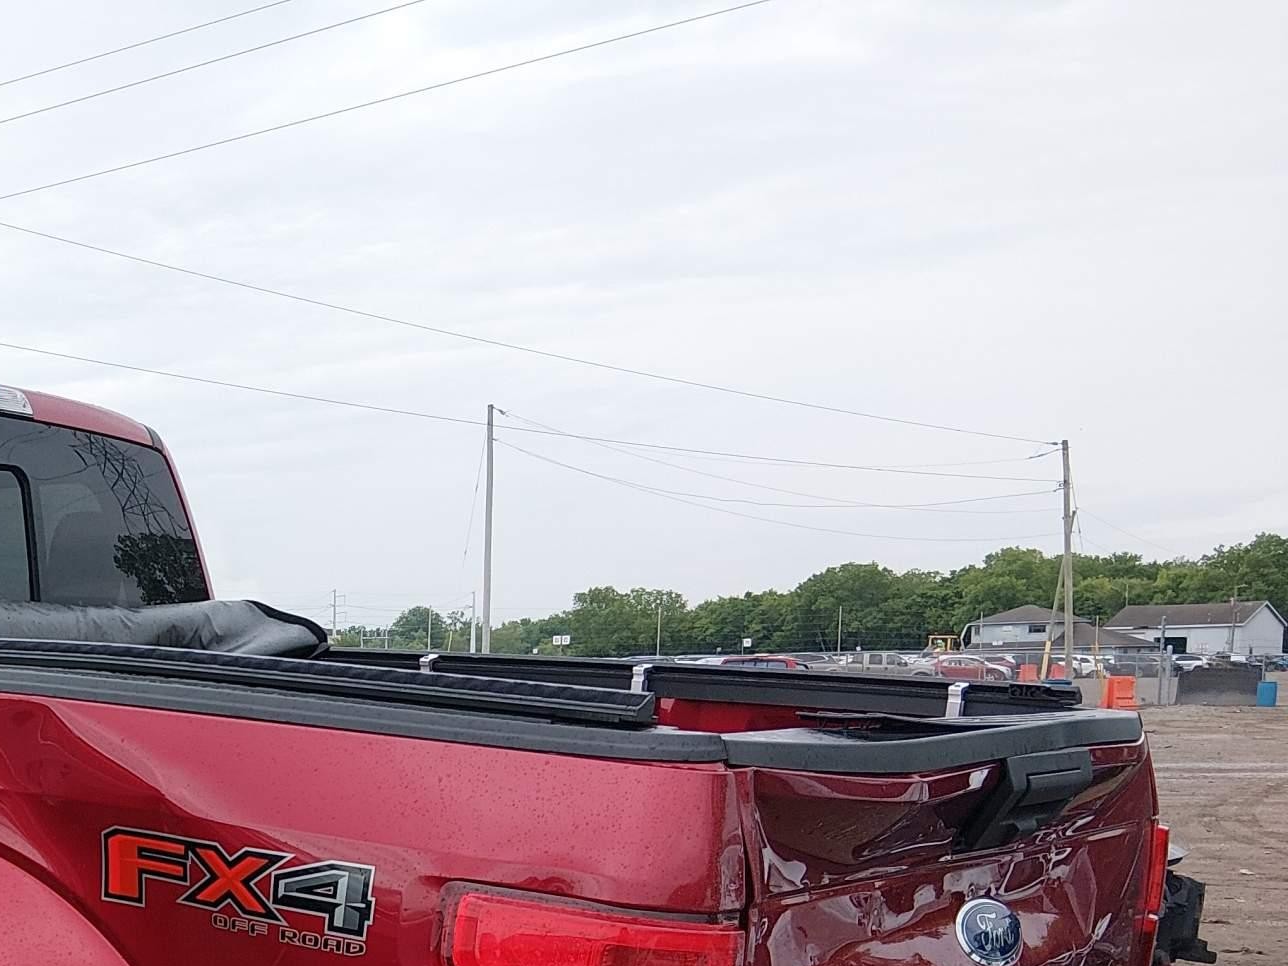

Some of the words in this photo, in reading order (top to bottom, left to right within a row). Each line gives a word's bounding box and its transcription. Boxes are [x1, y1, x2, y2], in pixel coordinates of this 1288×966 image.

[101, 825, 376, 942] FX4
[211, 913, 268, 937] OFF
[279, 928, 367, 957] ROAD
